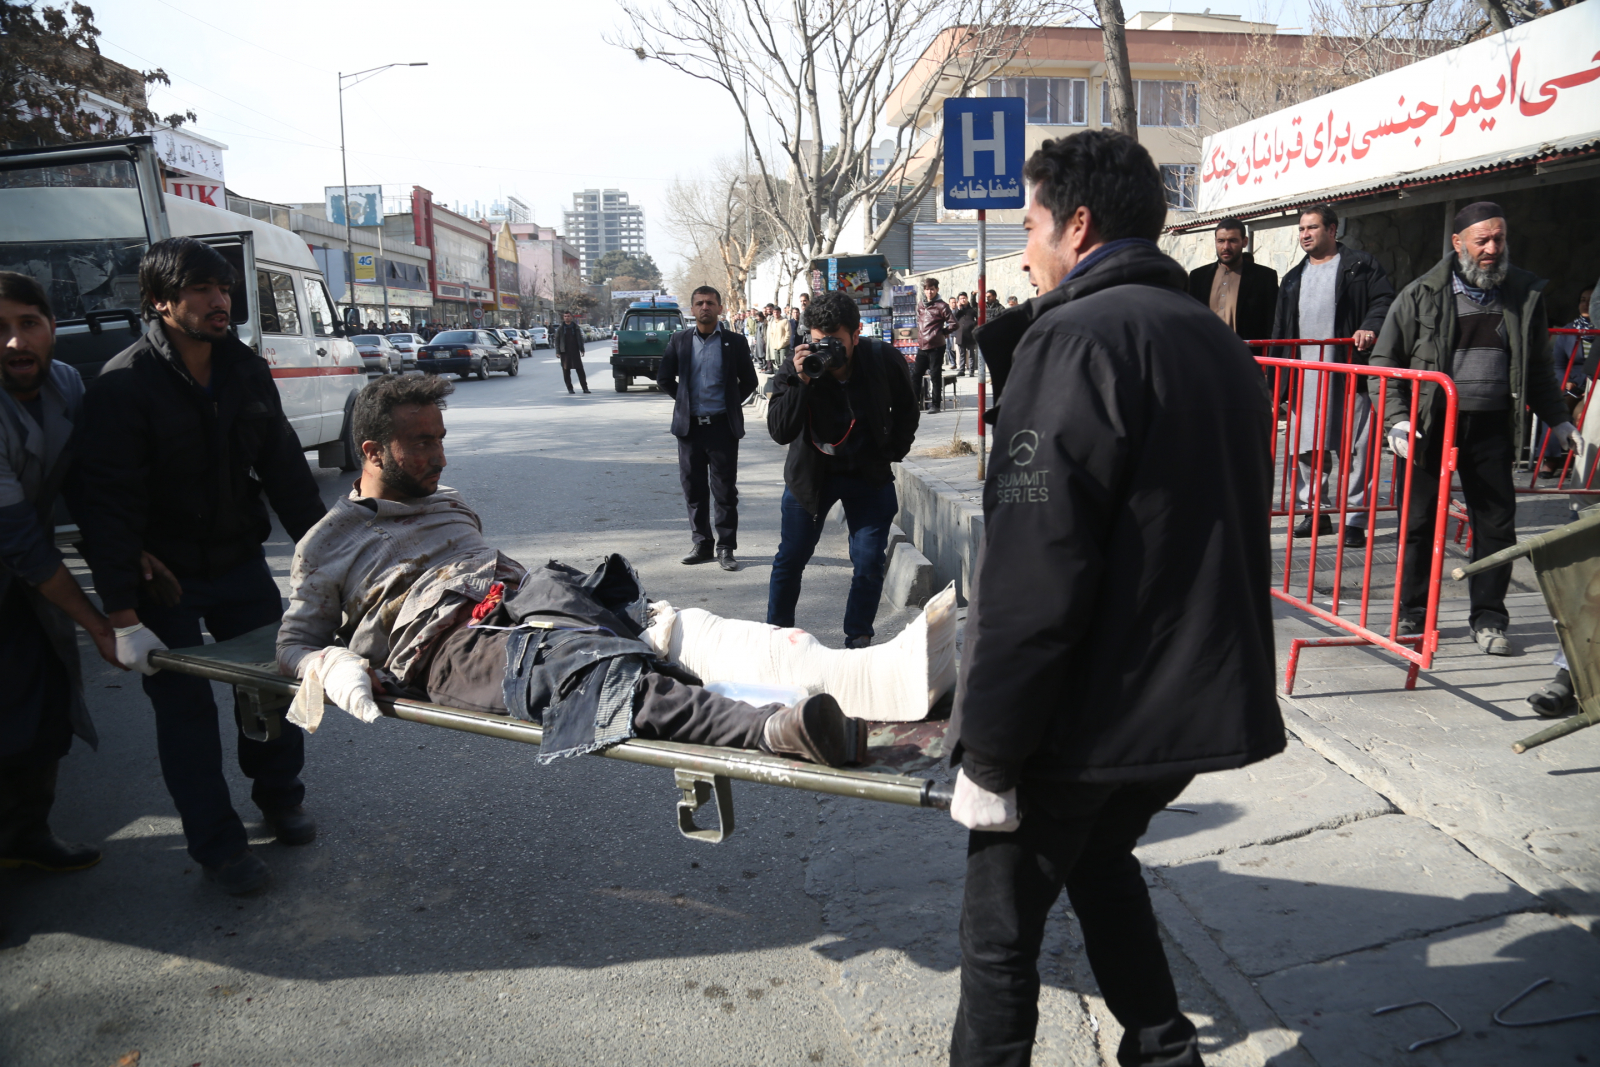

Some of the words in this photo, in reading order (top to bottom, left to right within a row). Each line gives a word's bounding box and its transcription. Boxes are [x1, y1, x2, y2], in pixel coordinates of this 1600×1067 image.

[961, 111, 1006, 177] H
[1236, 115, 1303, 186] قربانیان
[1304, 109, 1351, 168] برای
[1202, 145, 1237, 191] جنگ
[949, 177, 1020, 199] شفاخانه
[358, 255, 372, 266] 4G
[997, 470, 1049, 488] SUMMIT
[997, 487, 1049, 503] SERIES
